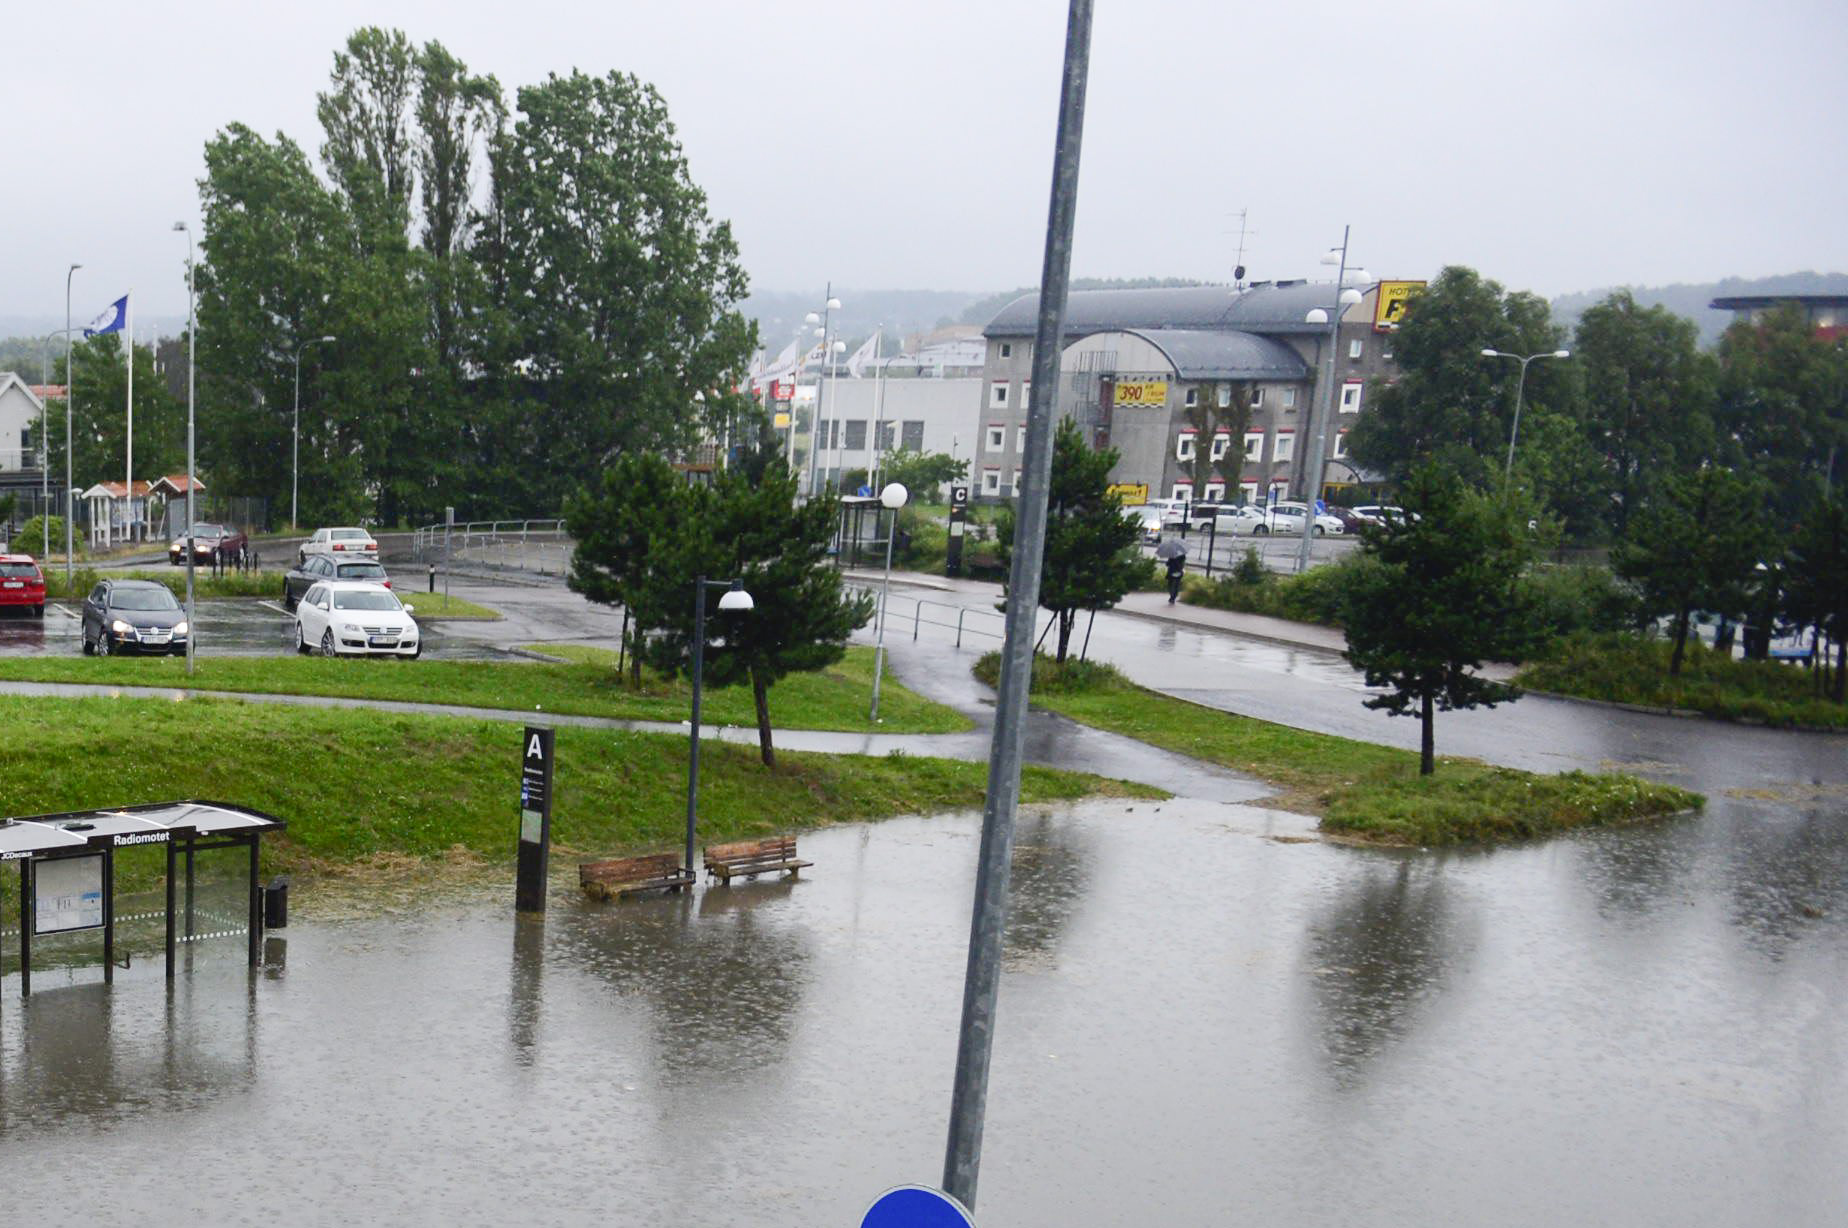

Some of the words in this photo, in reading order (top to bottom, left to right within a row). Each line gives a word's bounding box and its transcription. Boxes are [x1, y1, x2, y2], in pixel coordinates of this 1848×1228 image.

[1119, 385, 1143, 401] 390
[955, 488, 966, 501] C
[526, 733, 543, 760] A
[113, 831, 170, 846] Radiomotet
